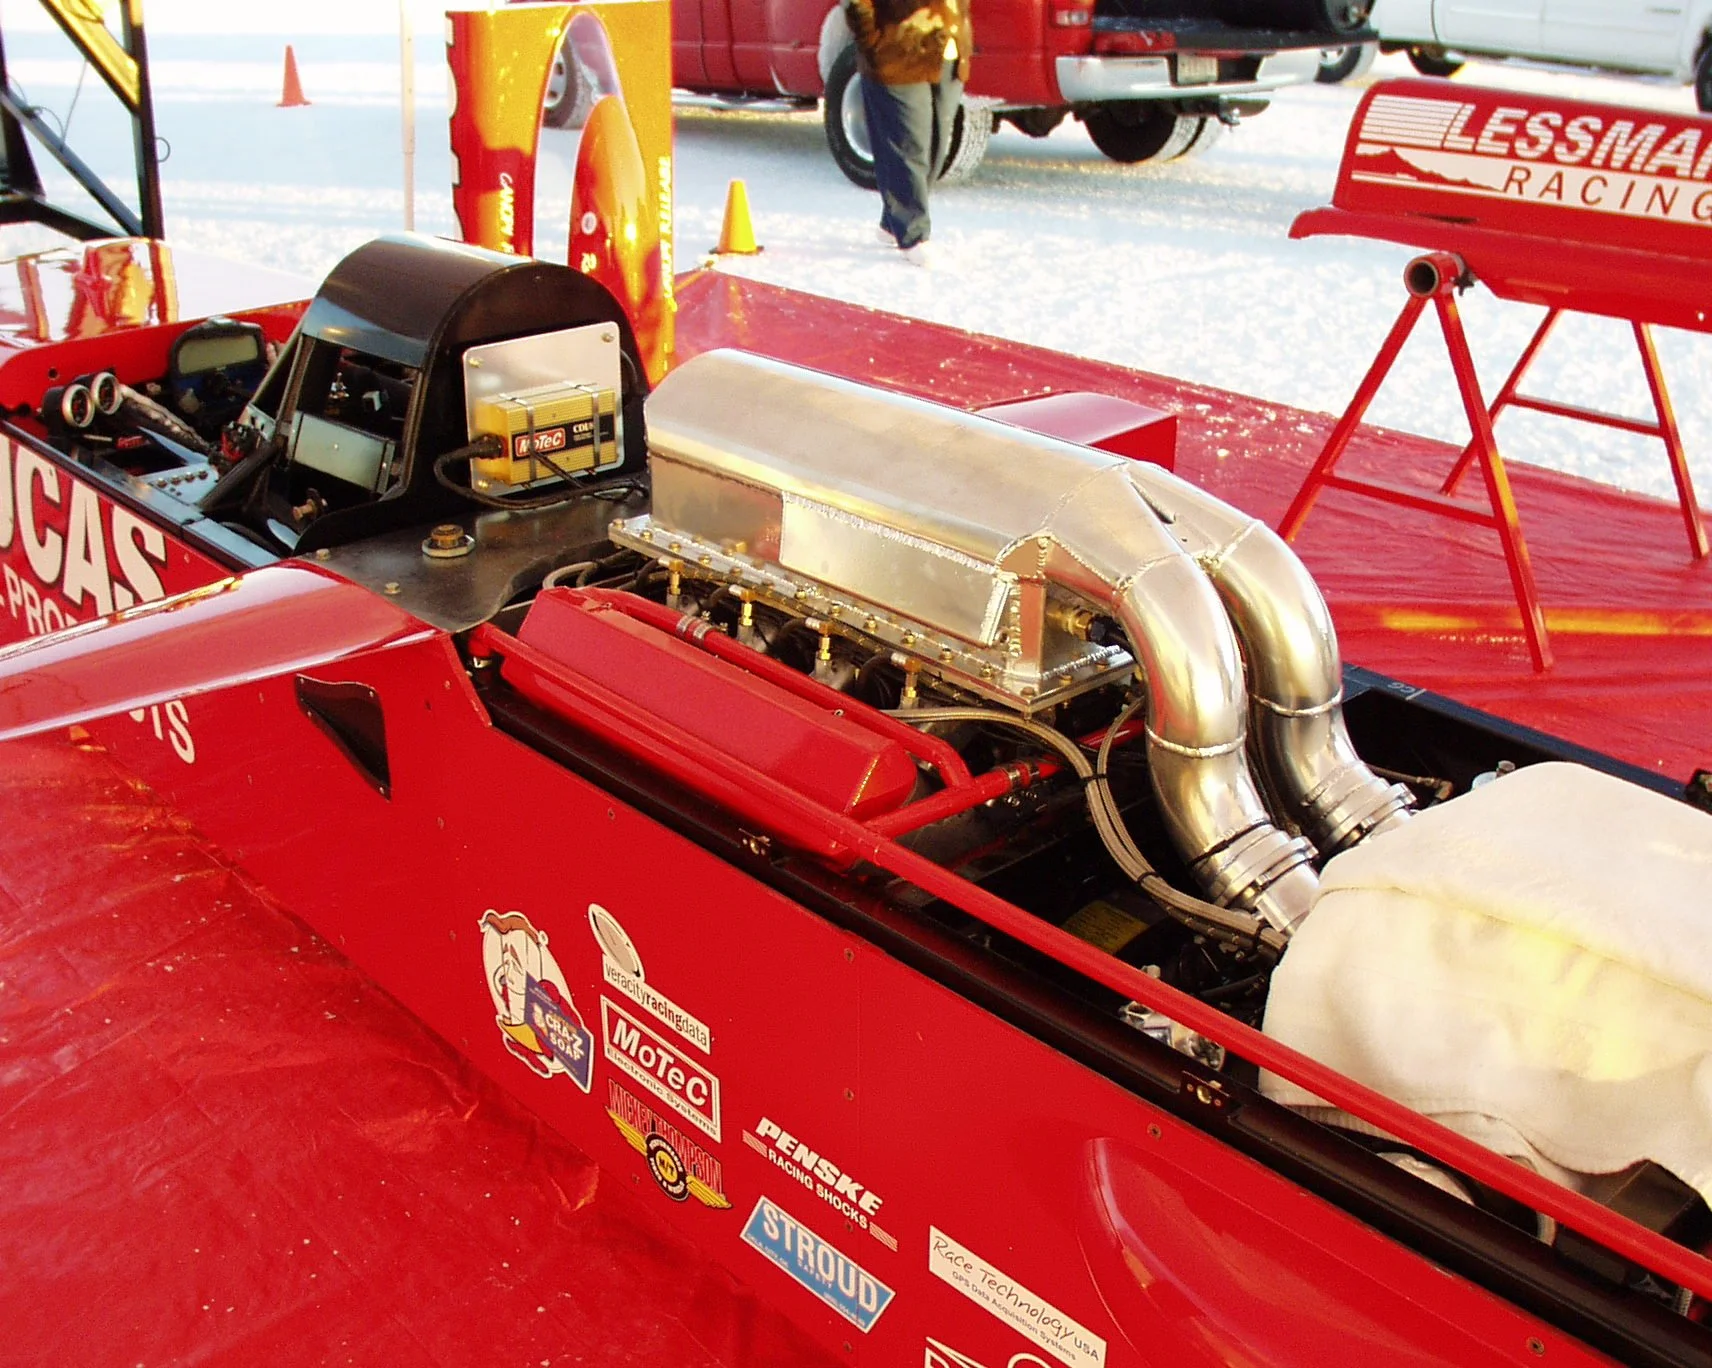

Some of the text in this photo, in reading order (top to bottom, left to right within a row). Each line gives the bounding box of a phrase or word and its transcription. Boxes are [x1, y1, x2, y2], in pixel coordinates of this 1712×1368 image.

[606, 1046, 665, 1097] Electronic
[666, 1091, 718, 1136] Systems
[612, 1017, 709, 1107] MoTeC
[755, 1116, 884, 1216] PENSKE
[768, 1148, 868, 1230] RACING SHOCKS
[763, 1202, 878, 1313] STROUD
[932, 1235, 974, 1274] Race
[979, 1268, 1075, 1341] Technology
[1074, 1335, 1100, 1361] USA
[951, 1270, 970, 1288] GPS
[971, 1284, 990, 1301] Data
[991, 1298, 1039, 1335] Acquisition
[1039, 1330, 1077, 1361] Systems
